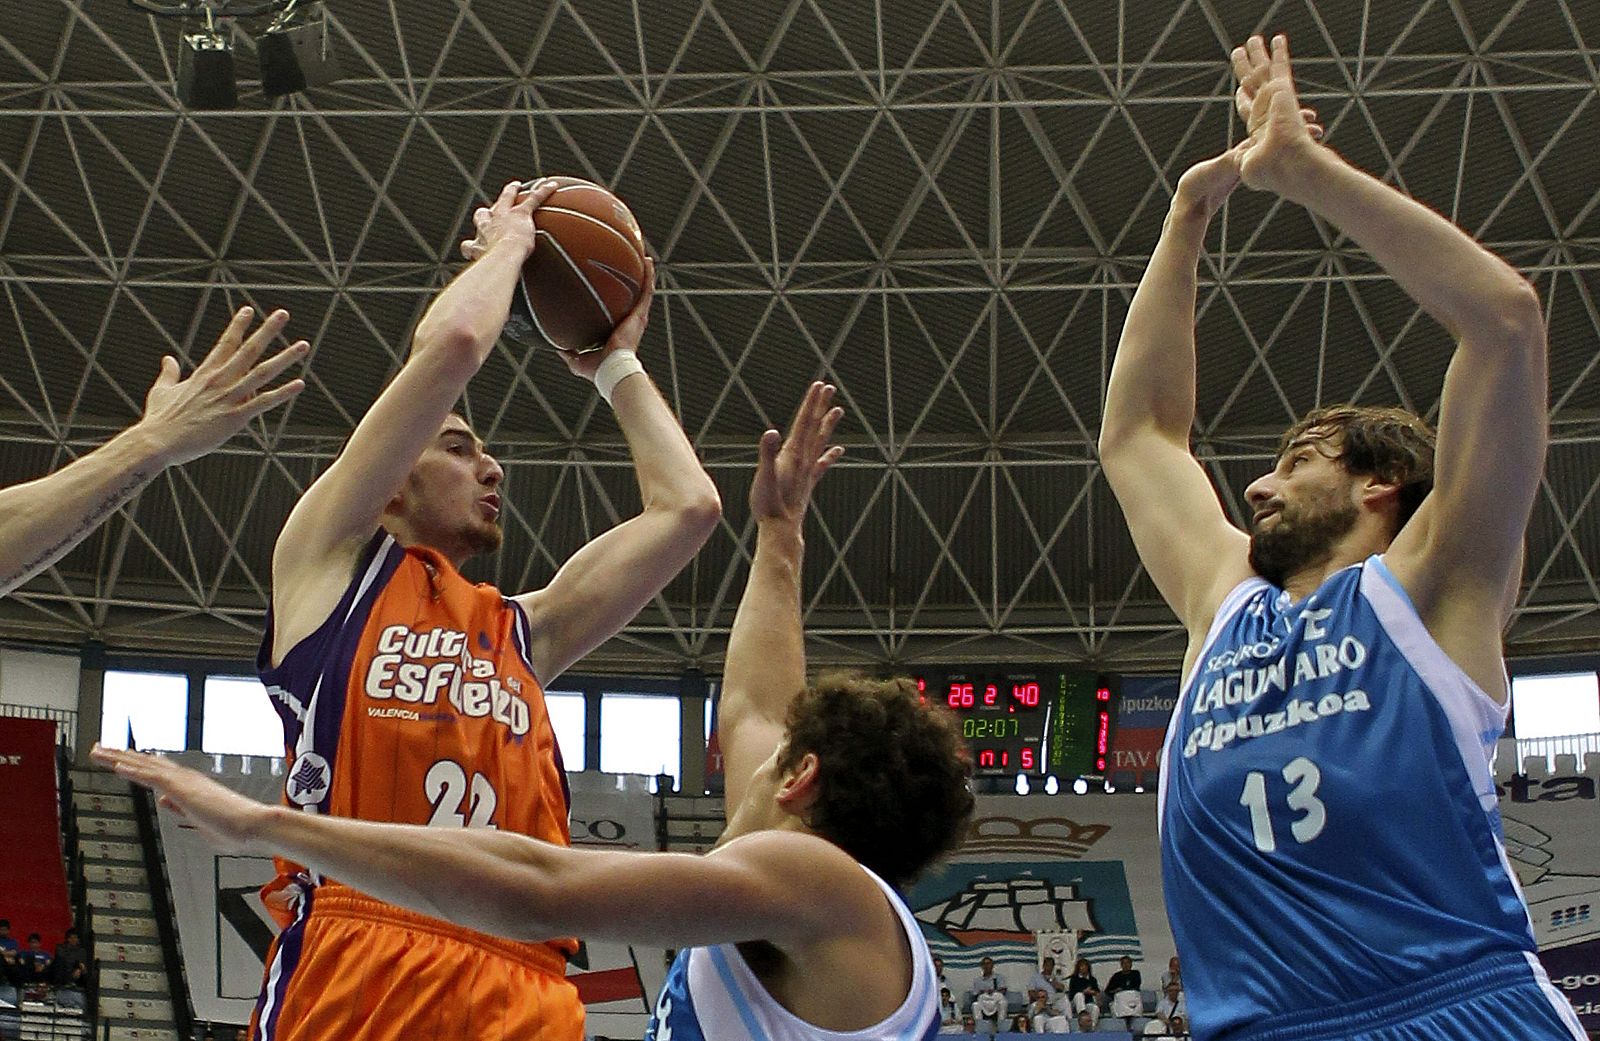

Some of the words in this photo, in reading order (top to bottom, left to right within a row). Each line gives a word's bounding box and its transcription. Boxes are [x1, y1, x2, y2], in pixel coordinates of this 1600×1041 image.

[377, 625, 496, 678] Culta
[1192, 657, 1287, 715] LAGUN
[1293, 635, 1366, 687] ARO
[948, 684, 974, 708] 26
[984, 684, 997, 706] 2
[1013, 682, 1039, 707] 40
[1119, 695, 1178, 714] ipuzko
[368, 707, 420, 721] VALENCIA
[964, 719, 1018, 738] 02:07
[1112, 750, 1152, 767] TAV
[424, 760, 497, 829] 22
[1239, 757, 1327, 852] 13
